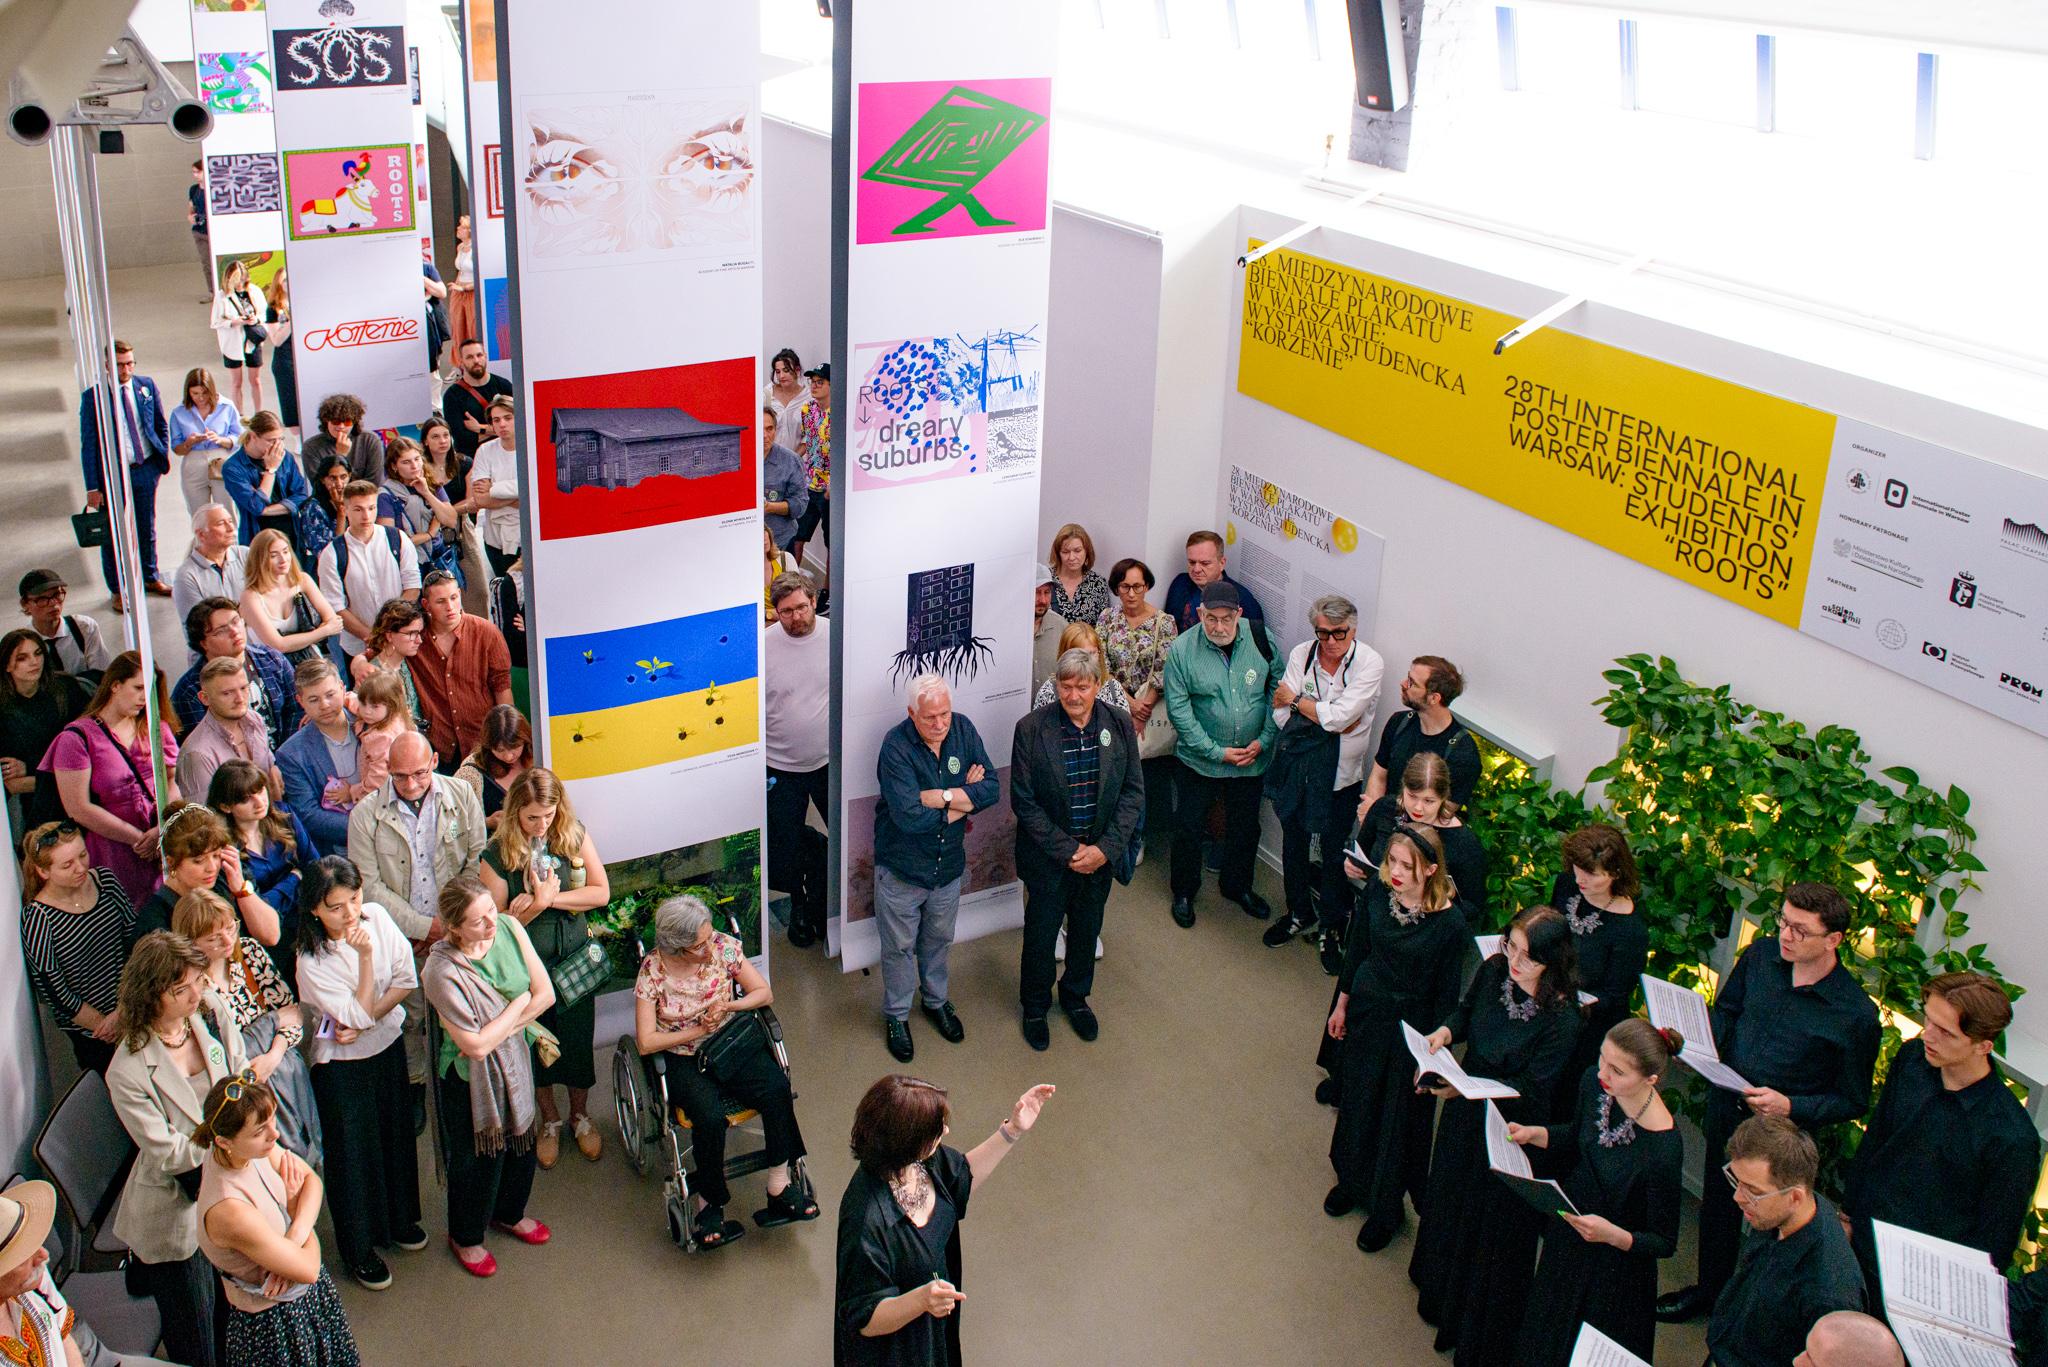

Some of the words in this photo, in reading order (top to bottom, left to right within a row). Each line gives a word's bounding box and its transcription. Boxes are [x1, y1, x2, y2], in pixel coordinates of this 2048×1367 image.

[287, 31, 392, 84] SOS
[387, 155, 403, 222] ROOTS
[1248, 283, 1264, 302] W
[1270, 289, 1387, 345] WARSZAWIE:
[1249, 265, 1341, 310] BIENNALE
[1348, 295, 1445, 343] PLAKATU
[1247, 300, 1334, 347] WYSTAWA
[1341, 332, 1467, 395] STUDENCKA
[859, 379, 930, 405] ROOTS
[858, 438, 963, 472] suburbs
[879, 415, 964, 443] dreary
[1504, 375, 1569, 416] 28TH
[1575, 398, 1806, 503] INTERNATIONAL
[1508, 423, 1626, 488] WARSAW:
[1851, 443, 1887, 459] ORGANIZER
[1511, 401, 1609, 457] POSTER
[1616, 440, 1762, 513] BIENNALE
[1770, 494, 1803, 528] IN
[1229, 494, 1272, 523] WYSTAWA
[1273, 514, 1331, 554] STUDENCKA
[1277, 497, 1322, 526] PLAKATU
[1624, 494, 1793, 581] EXHIBITION
[1839, 513, 1872, 529] HONORARY
[1826, 576, 1857, 592] PARTNERS
[2000, 672, 2044, 698] PROM
